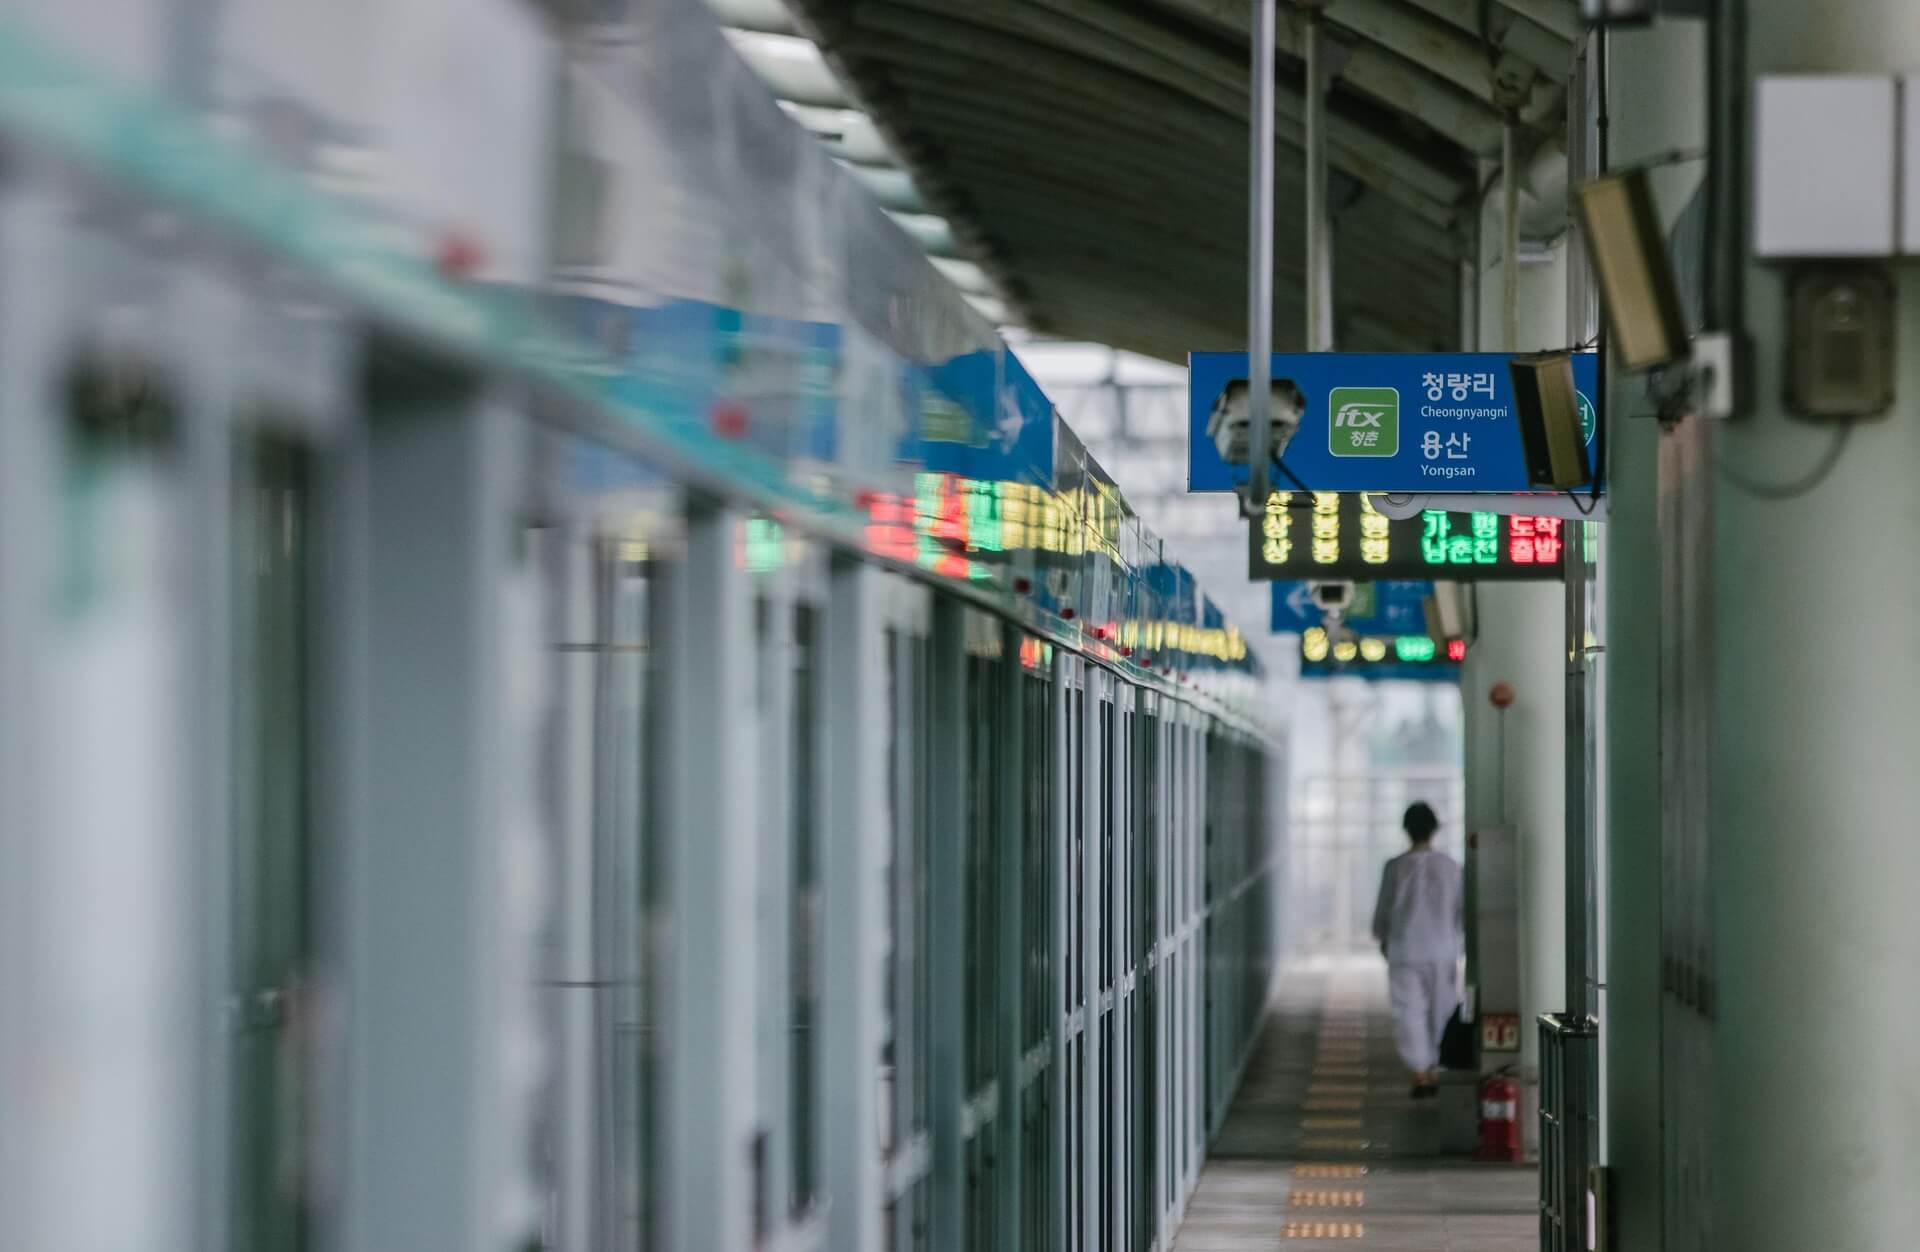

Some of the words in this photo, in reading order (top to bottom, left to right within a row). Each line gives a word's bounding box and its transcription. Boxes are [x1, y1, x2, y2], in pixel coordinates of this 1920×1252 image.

[1421, 372, 1495, 401] 청량리
[1420, 405, 1508, 421] Cheongnyangni
[1350, 430, 1380, 447] 청춘
[1420, 430, 1471, 460] 용산
[1420, 464, 1476, 479] Yongsan
